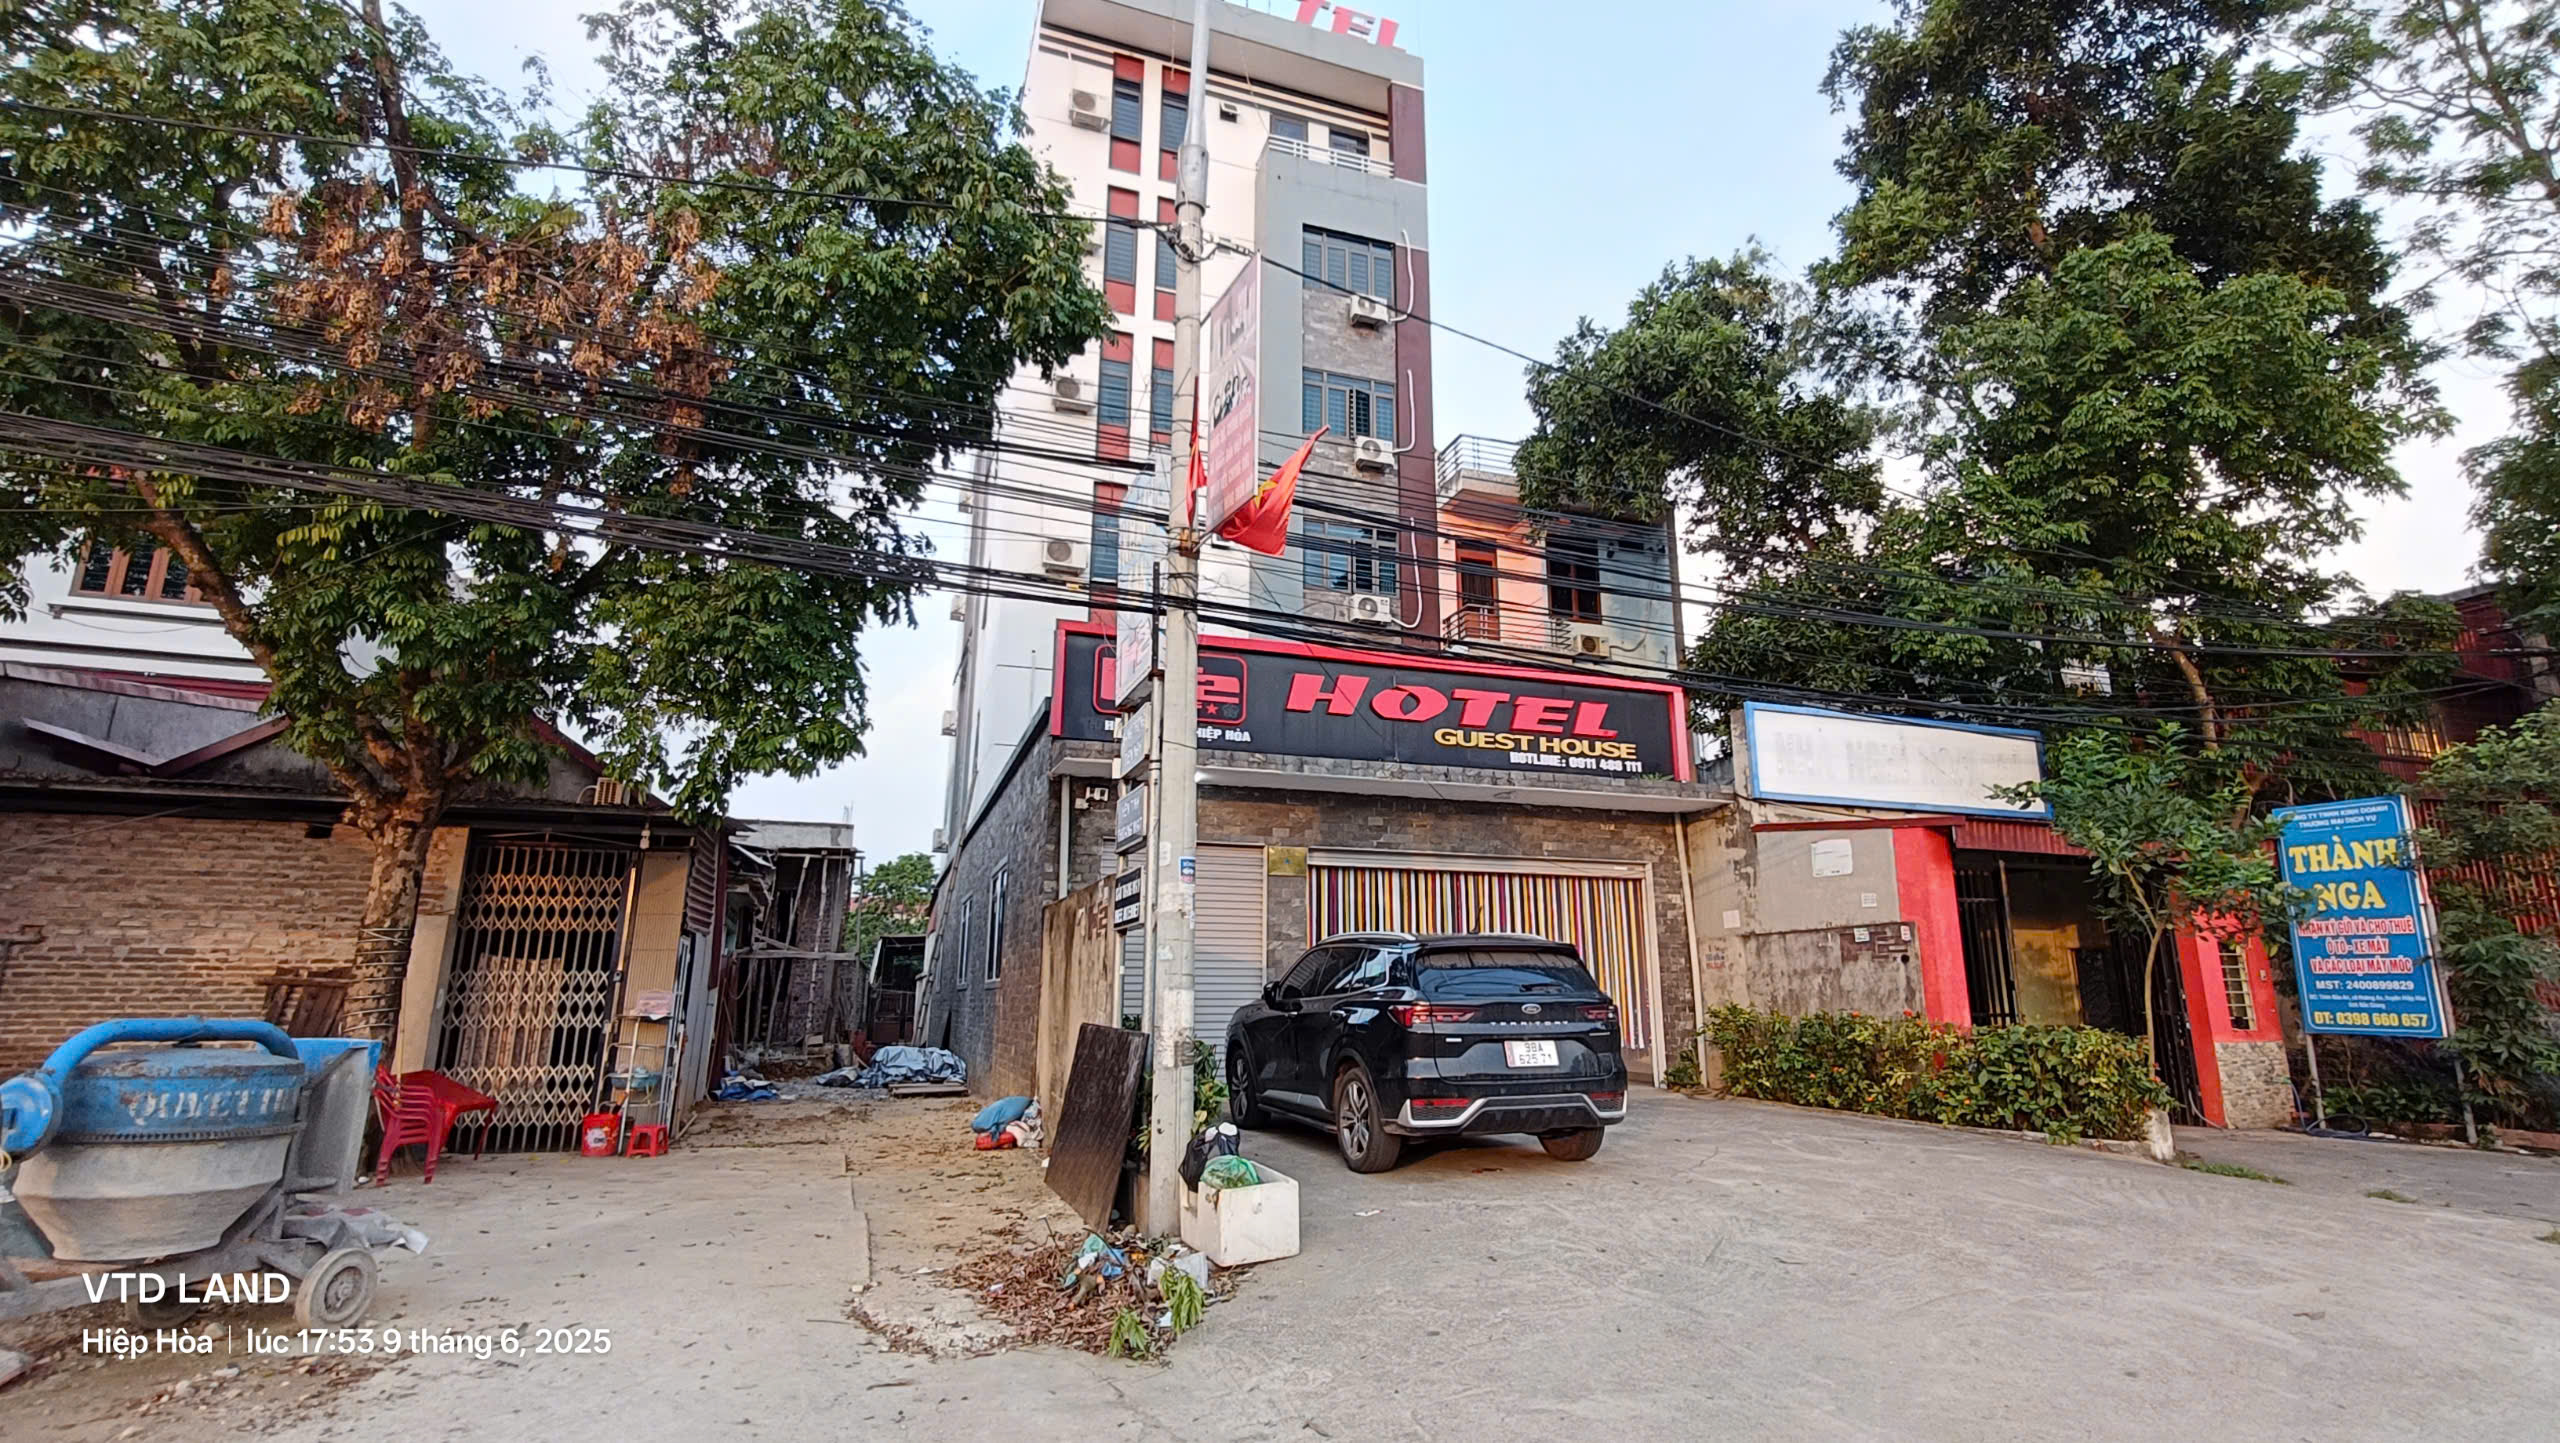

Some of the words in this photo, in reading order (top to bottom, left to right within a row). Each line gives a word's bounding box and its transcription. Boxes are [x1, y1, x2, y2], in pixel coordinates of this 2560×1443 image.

[1285, 672, 1618, 738] HOTEL
[1434, 727, 1535, 751] GUEST
[1538, 736, 1637, 759] HOUSE
[2288, 835, 2399, 873] THÀNH
[2313, 880, 2386, 912] NGA
[2368, 919, 2388, 935] CHO
[2316, 980, 2343, 990] MST:
[2336, 1012, 2370, 1025] 0398
[2372, 1013, 2399, 1026] 660
[2401, 1013, 2428, 1028] 657
